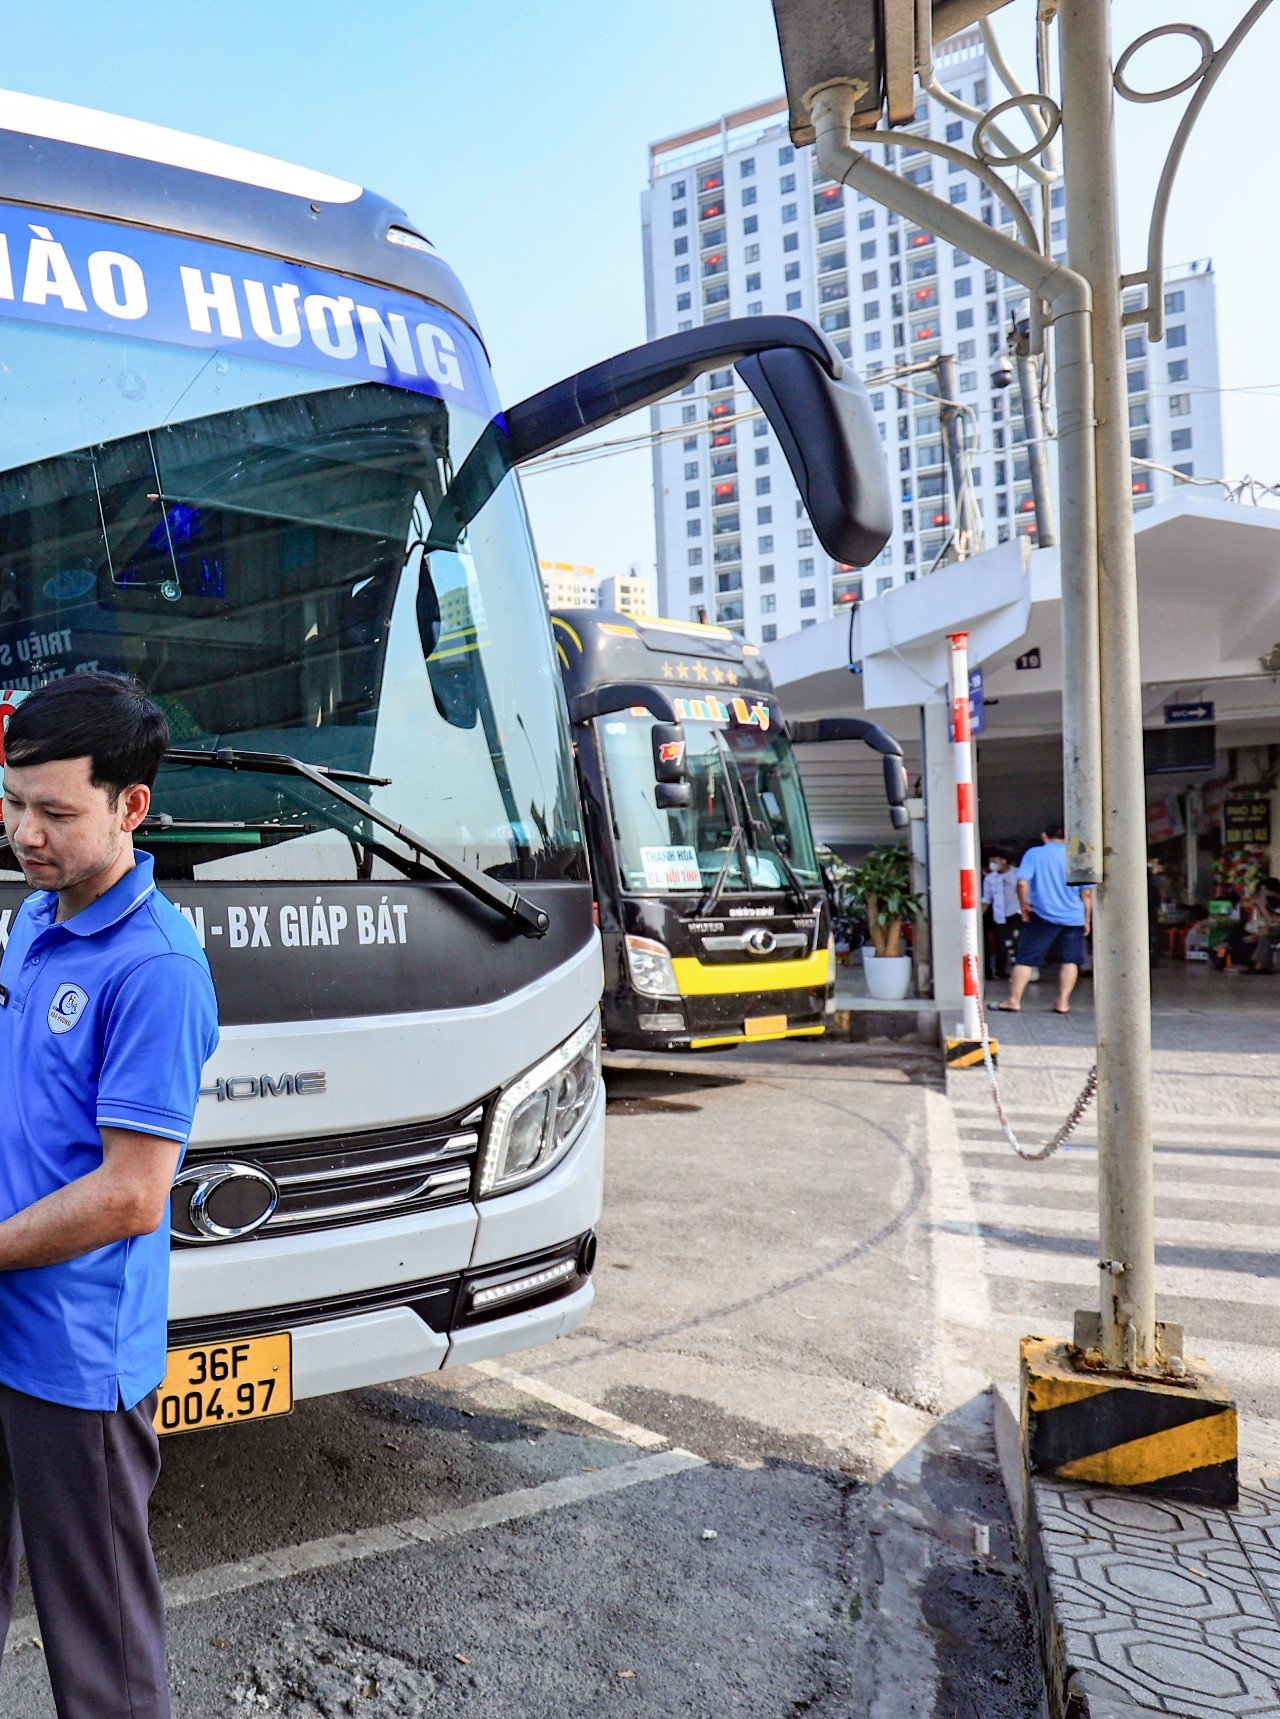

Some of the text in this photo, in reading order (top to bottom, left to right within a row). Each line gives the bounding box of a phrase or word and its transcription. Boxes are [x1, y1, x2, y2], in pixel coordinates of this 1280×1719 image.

[179, 264, 465, 391] HƯƠNG
[279, 896, 348, 947] GIÁP
[356, 895, 409, 945] BÁT
[188, 1344, 250, 1385] 36F
[162, 1378, 276, 1430] 004.97
